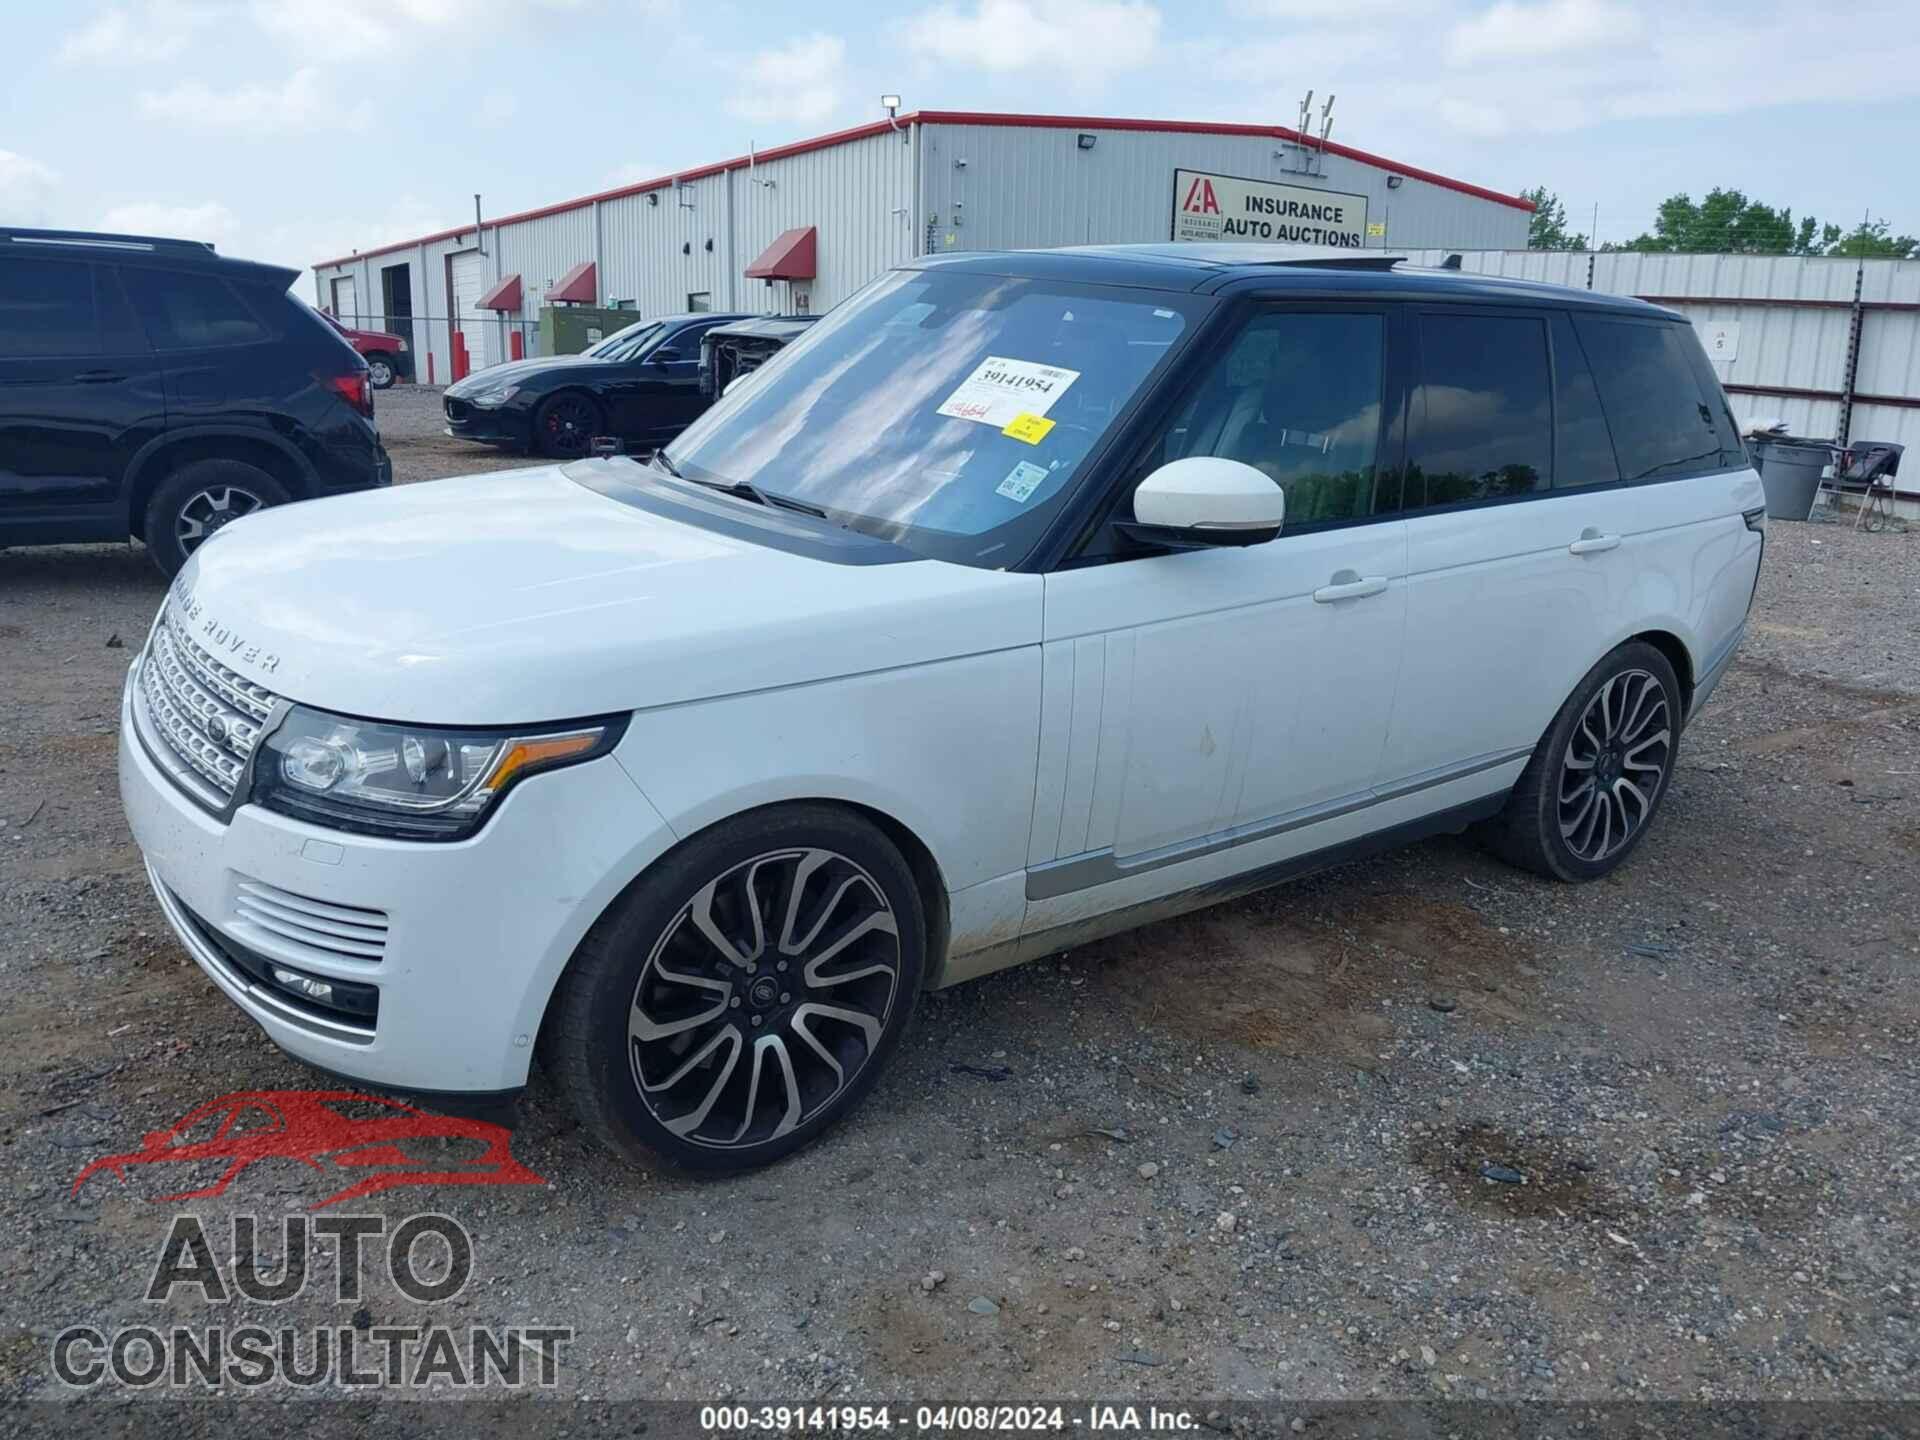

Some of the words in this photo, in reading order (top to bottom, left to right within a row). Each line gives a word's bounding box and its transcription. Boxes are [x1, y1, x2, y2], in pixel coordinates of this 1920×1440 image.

[1245, 195, 1343, 223] INSURANCE
[1223, 217, 1272, 238] AUTO
[1276, 223, 1361, 248] AUCTIONS
[977, 369, 1054, 394] 39141954
[201, 618, 281, 673] ROVER
